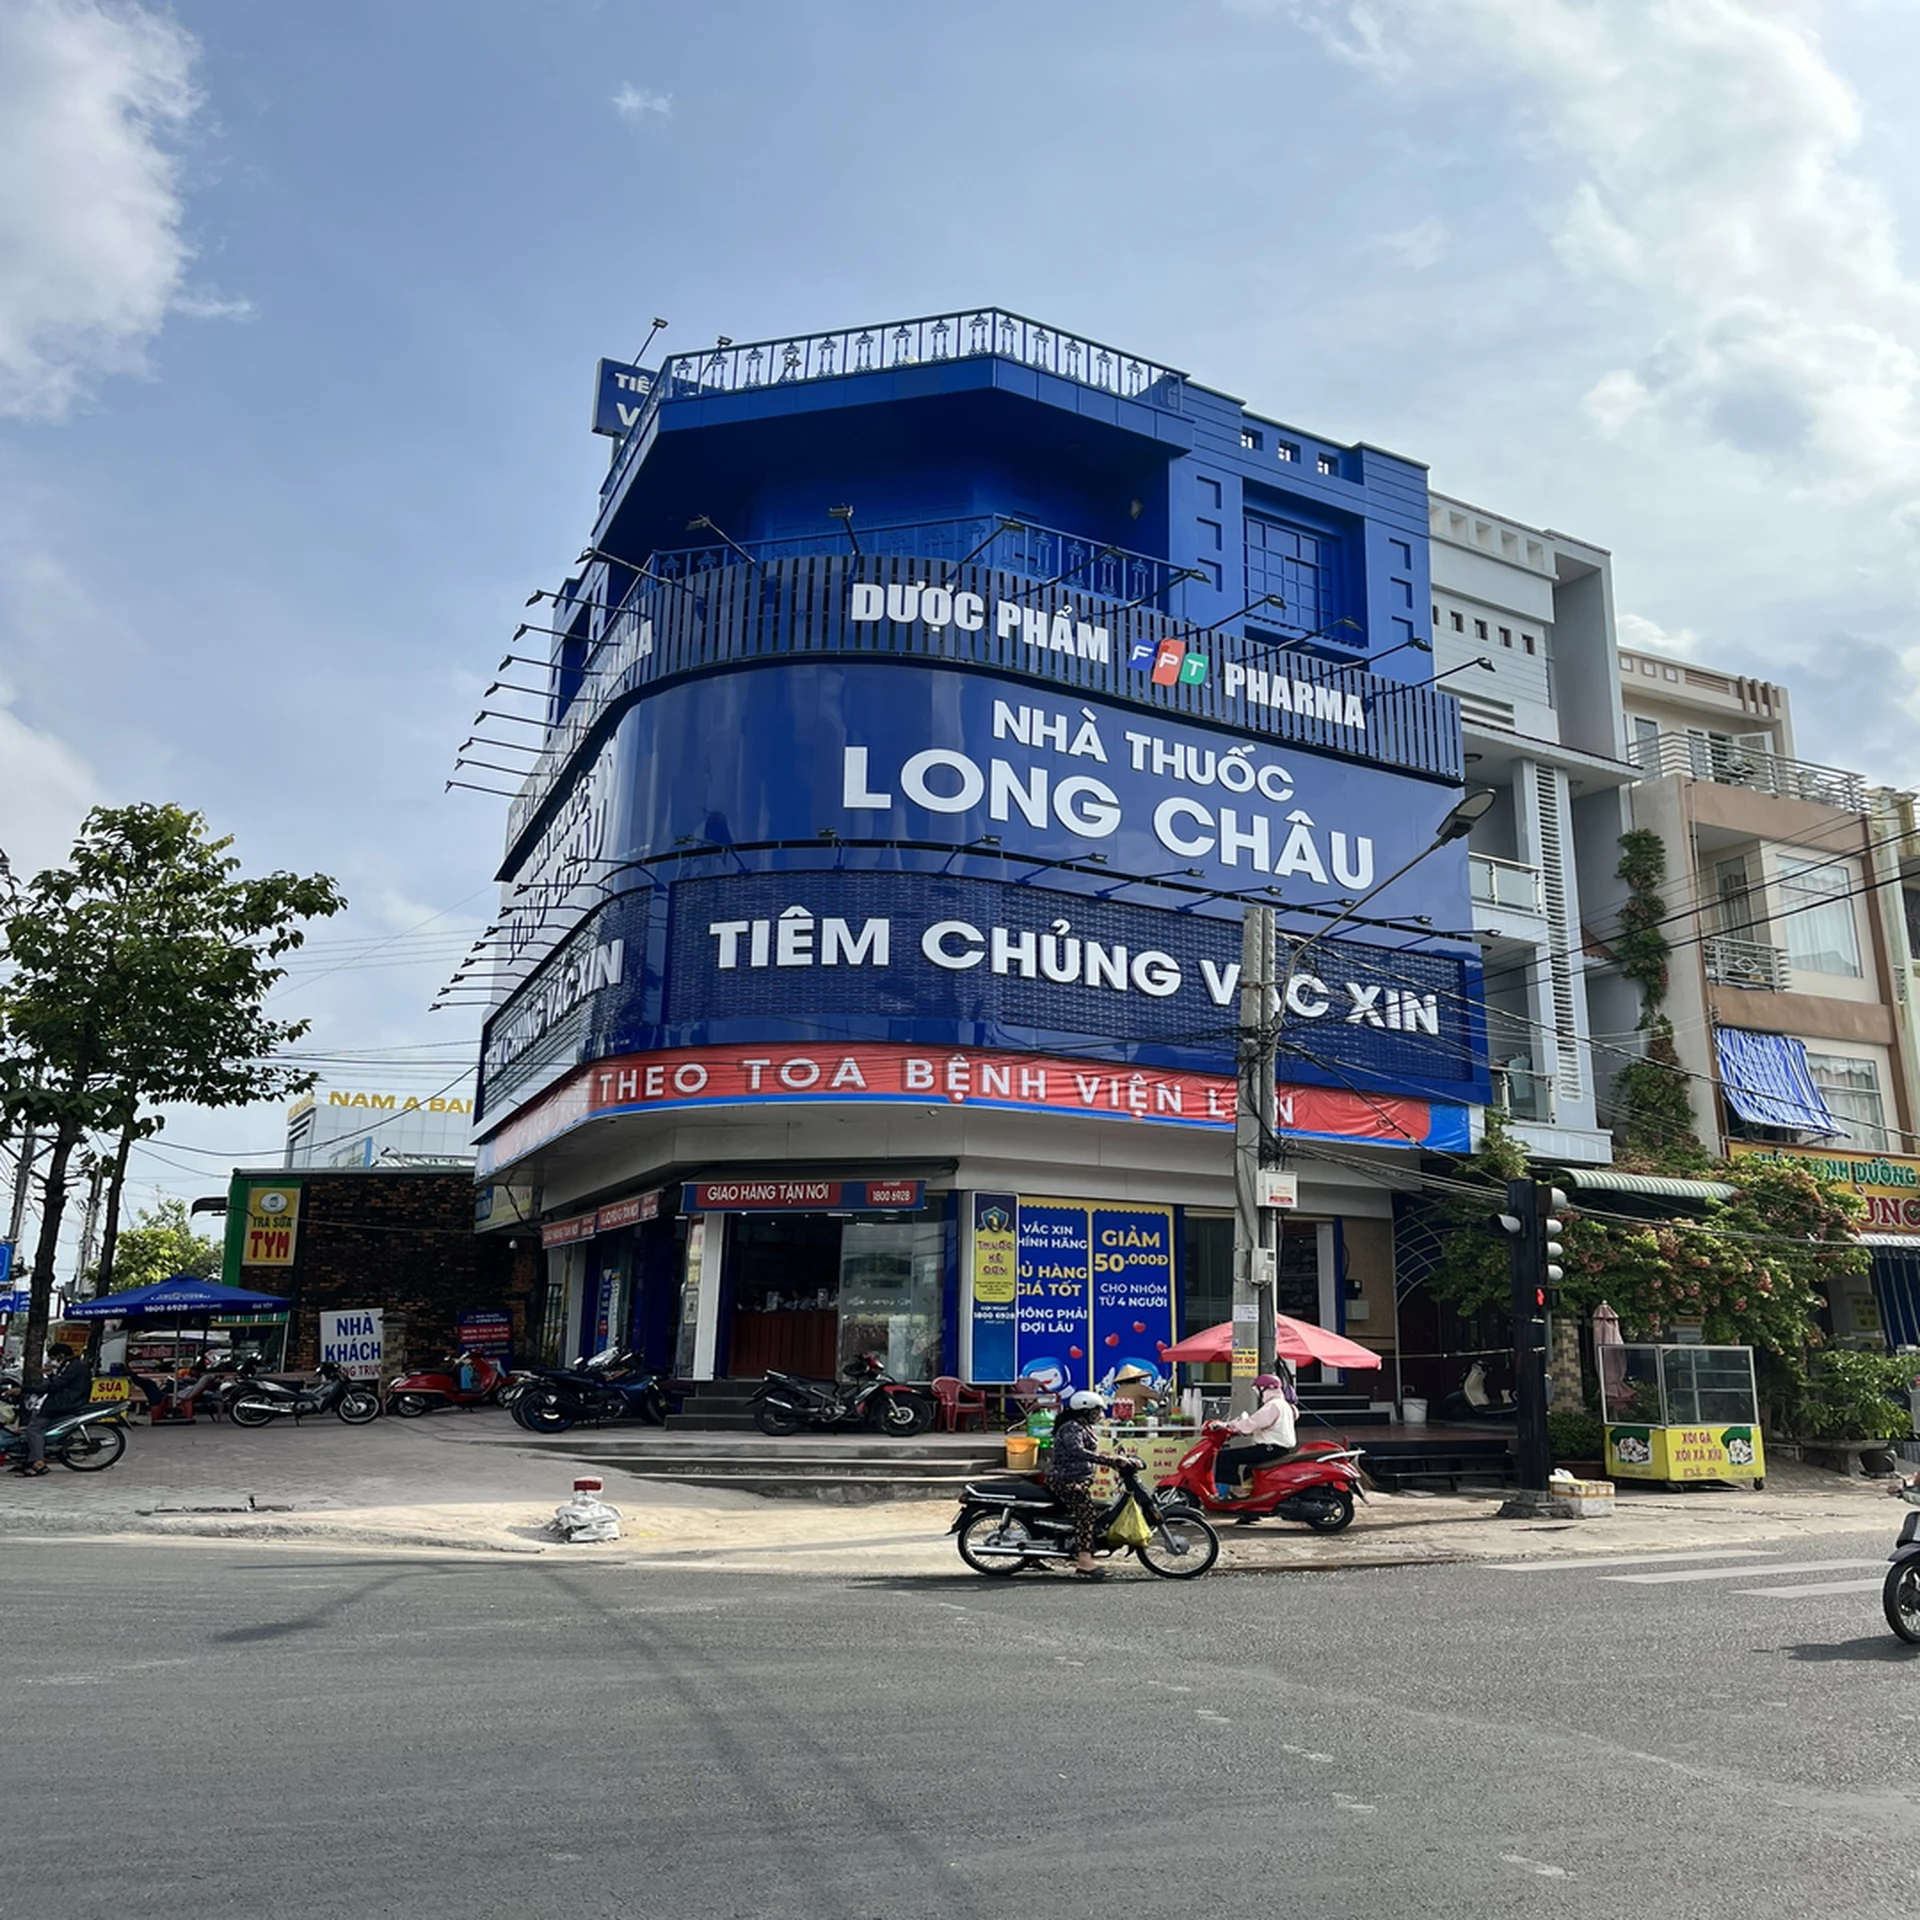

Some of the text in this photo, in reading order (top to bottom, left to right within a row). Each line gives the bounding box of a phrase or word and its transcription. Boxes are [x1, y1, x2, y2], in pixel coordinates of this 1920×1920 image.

[615, 372, 655, 397] TIÊ
[852, 581, 984, 632] DƯỢC
[997, 604, 1109, 664] PHẨM
[1225, 662, 1366, 730] PHARMA
[993, 699, 1295, 801] NHÀ THUỐC
[842, 746, 1375, 890] LONG CHÂU
[709, 904, 1439, 1035] TIÊM CHỦNG VC XIN
[600, 1054, 1294, 1124] THEO TOA BỆNH VIỆN LN
[329, 1091, 395, 1110] NAM
[707, 1183, 829, 1204] GIAO HÀNG TẬN NƠI
[872, 1189, 910, 1202] 1800 6928
[1022, 1221, 1073, 1236] VẮC XIN
[1101, 1225, 1161, 1248] GIẢM
[250, 1230, 290, 1259] TYM
[1018, 1236, 1087, 1250] HÍNH HÃNG
[1038, 1262, 1087, 1279] HÀNG
[1017, 1280, 1044, 1296] GIÁ
[1048, 1279, 1082, 1297] TỐT
[1100, 1282, 1167, 1294] CHO NHÓM
[166, 1303, 189, 1311] 6928
[1099, 1295, 1168, 1308] TỪ 4 NGƯỜI
[1018, 1305, 1087, 1320] HÔNG PHẢI
[337, 1311, 374, 1336] NHÀ
[1020, 1321, 1074, 1335] ĐỢI LÂU
[325, 1337, 381, 1362] KHÁCH
